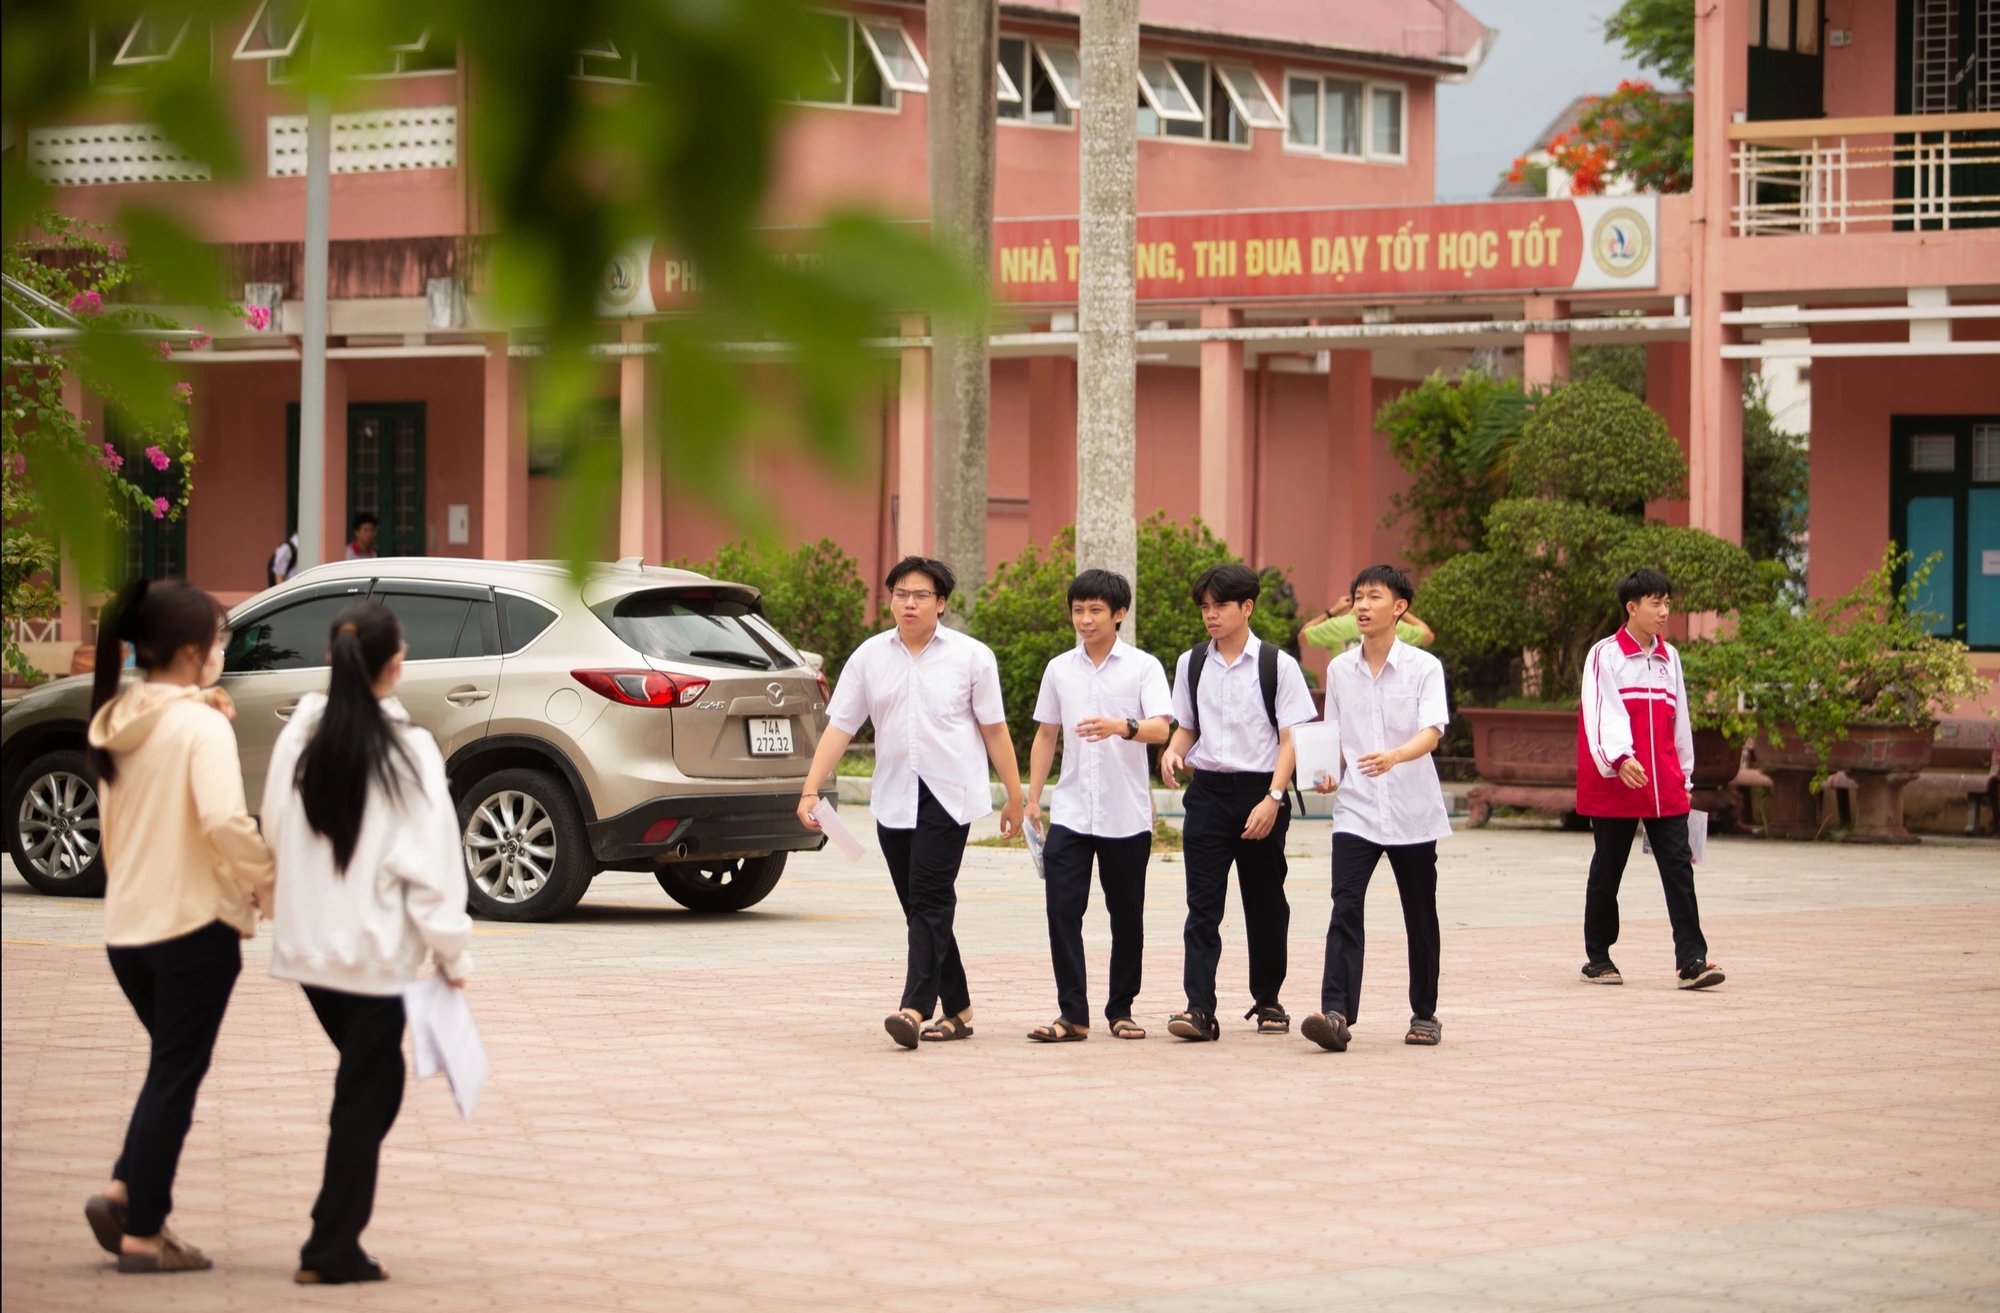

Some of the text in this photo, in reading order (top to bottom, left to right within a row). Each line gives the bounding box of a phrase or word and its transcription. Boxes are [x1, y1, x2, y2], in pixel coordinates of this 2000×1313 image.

[1001, 238, 1058, 283] NHÀ
[1064, 241, 1184, 284] TNG,
[1192, 239, 1238, 278] THI
[1244, 237, 1302, 277] ĐUA
[1310, 235, 1368, 282] DẠY
[1376, 219, 1430, 272] TỐT
[1437, 230, 1499, 278] HỌC
[1507, 214, 1563, 268] TỐT
[761, 720, 780, 736] 74A
[756, 737, 790, 752] 272.32
